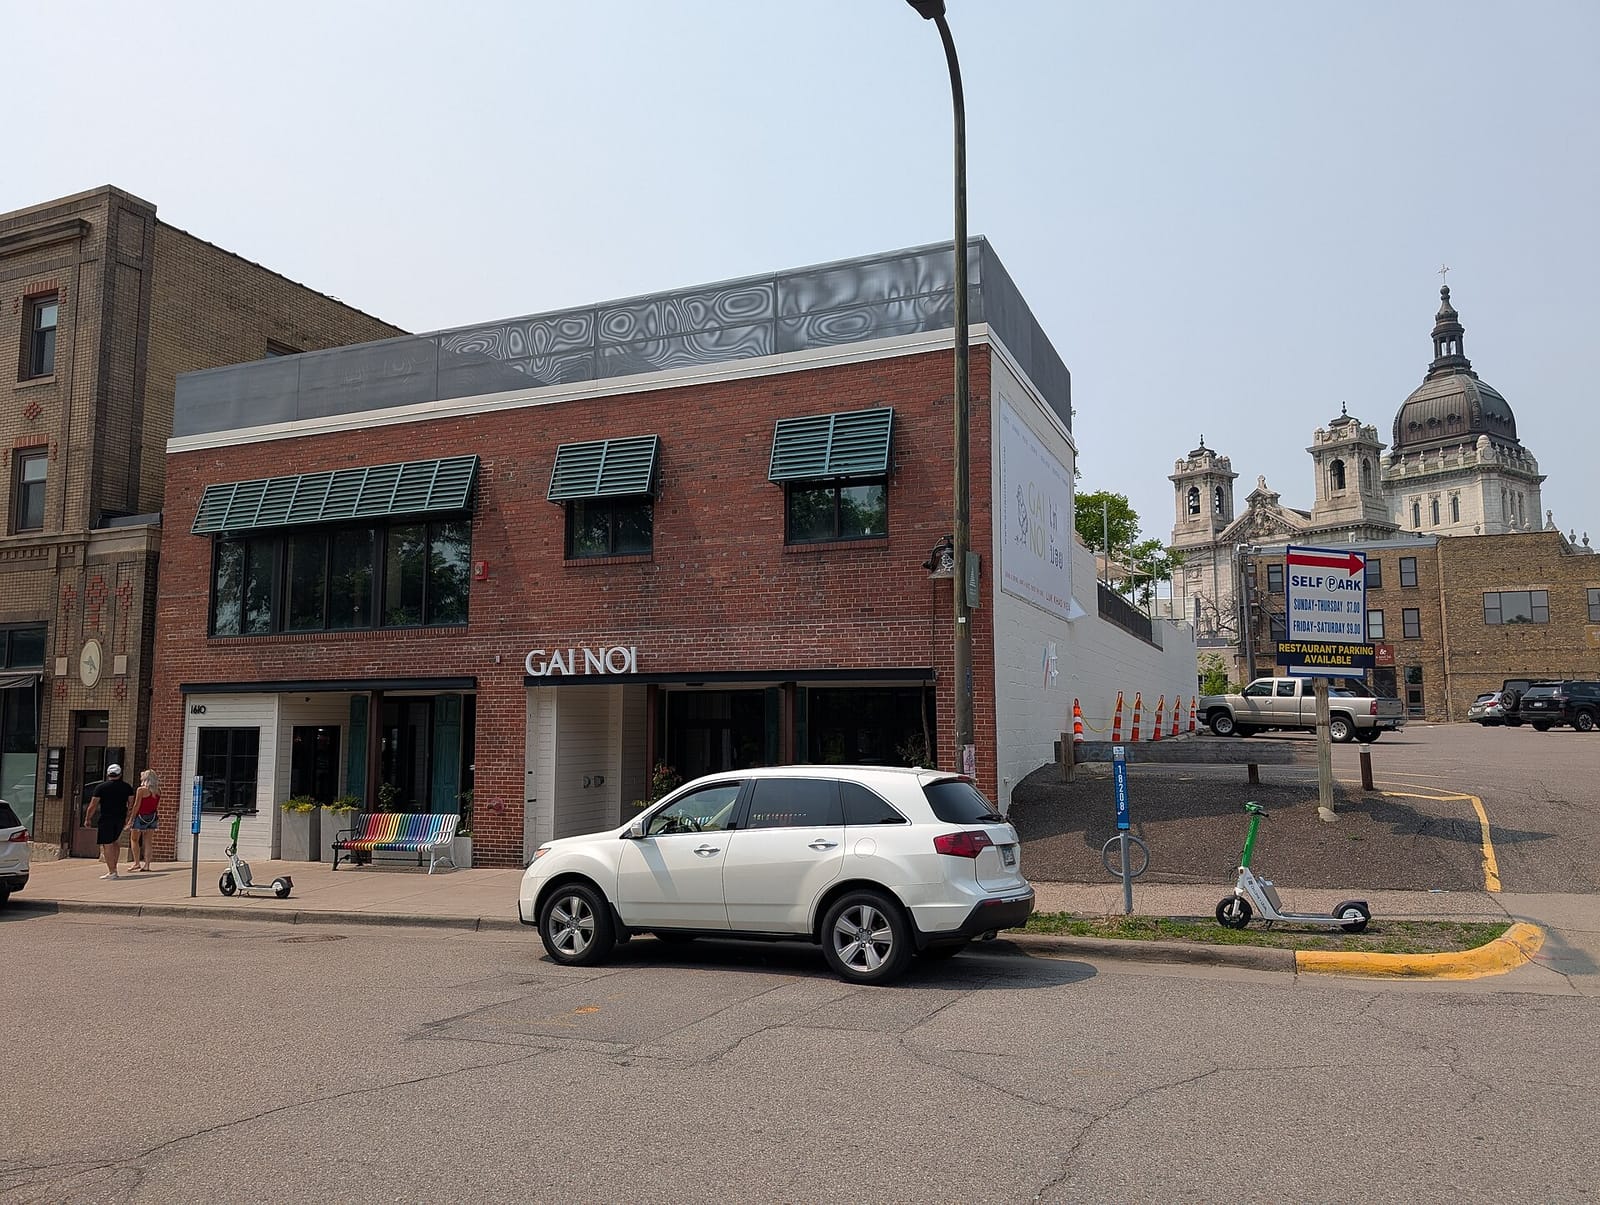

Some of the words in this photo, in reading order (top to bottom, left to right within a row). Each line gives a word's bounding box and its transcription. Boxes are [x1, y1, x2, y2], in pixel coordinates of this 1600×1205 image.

[1029, 518, 1045, 561] NOI
[1291, 575, 1323, 588] SELF
[1325, 575, 1362, 592] PARK
[1293, 598, 1343, 613] SUNDAY-THURSDAY
[1293, 620, 1346, 634] FRIDAY-SATURDAY
[1278, 643, 1336, 654] RESTAURANT
[1338, 644, 1374, 656] PARKING
[525, 649, 576, 676] GAI
[583, 646, 638, 675] NOI
[1304, 655, 1352, 665] AVAILABLE
